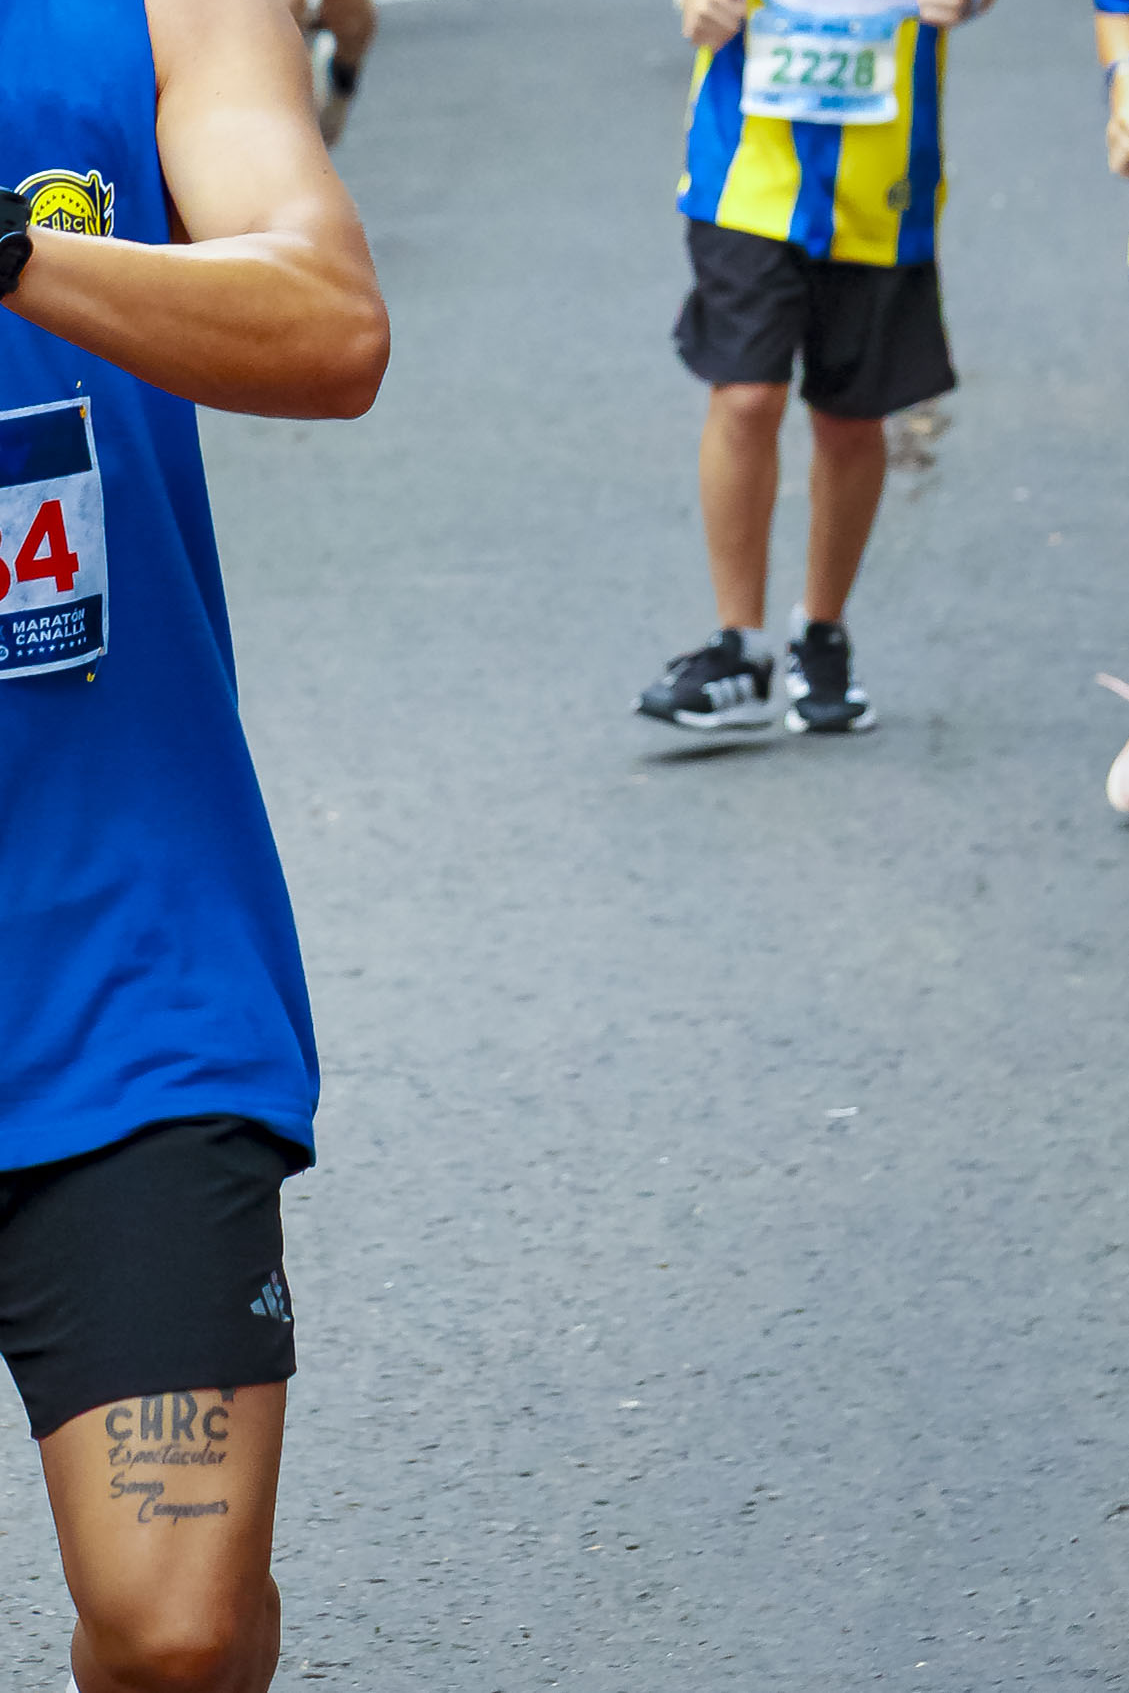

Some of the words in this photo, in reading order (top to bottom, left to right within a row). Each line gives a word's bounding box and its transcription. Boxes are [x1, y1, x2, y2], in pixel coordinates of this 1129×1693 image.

[770, 46, 875, 90] 2228
[12, 608, 86, 634] MARATÓN
[15, 621, 87, 646] CANALLA
